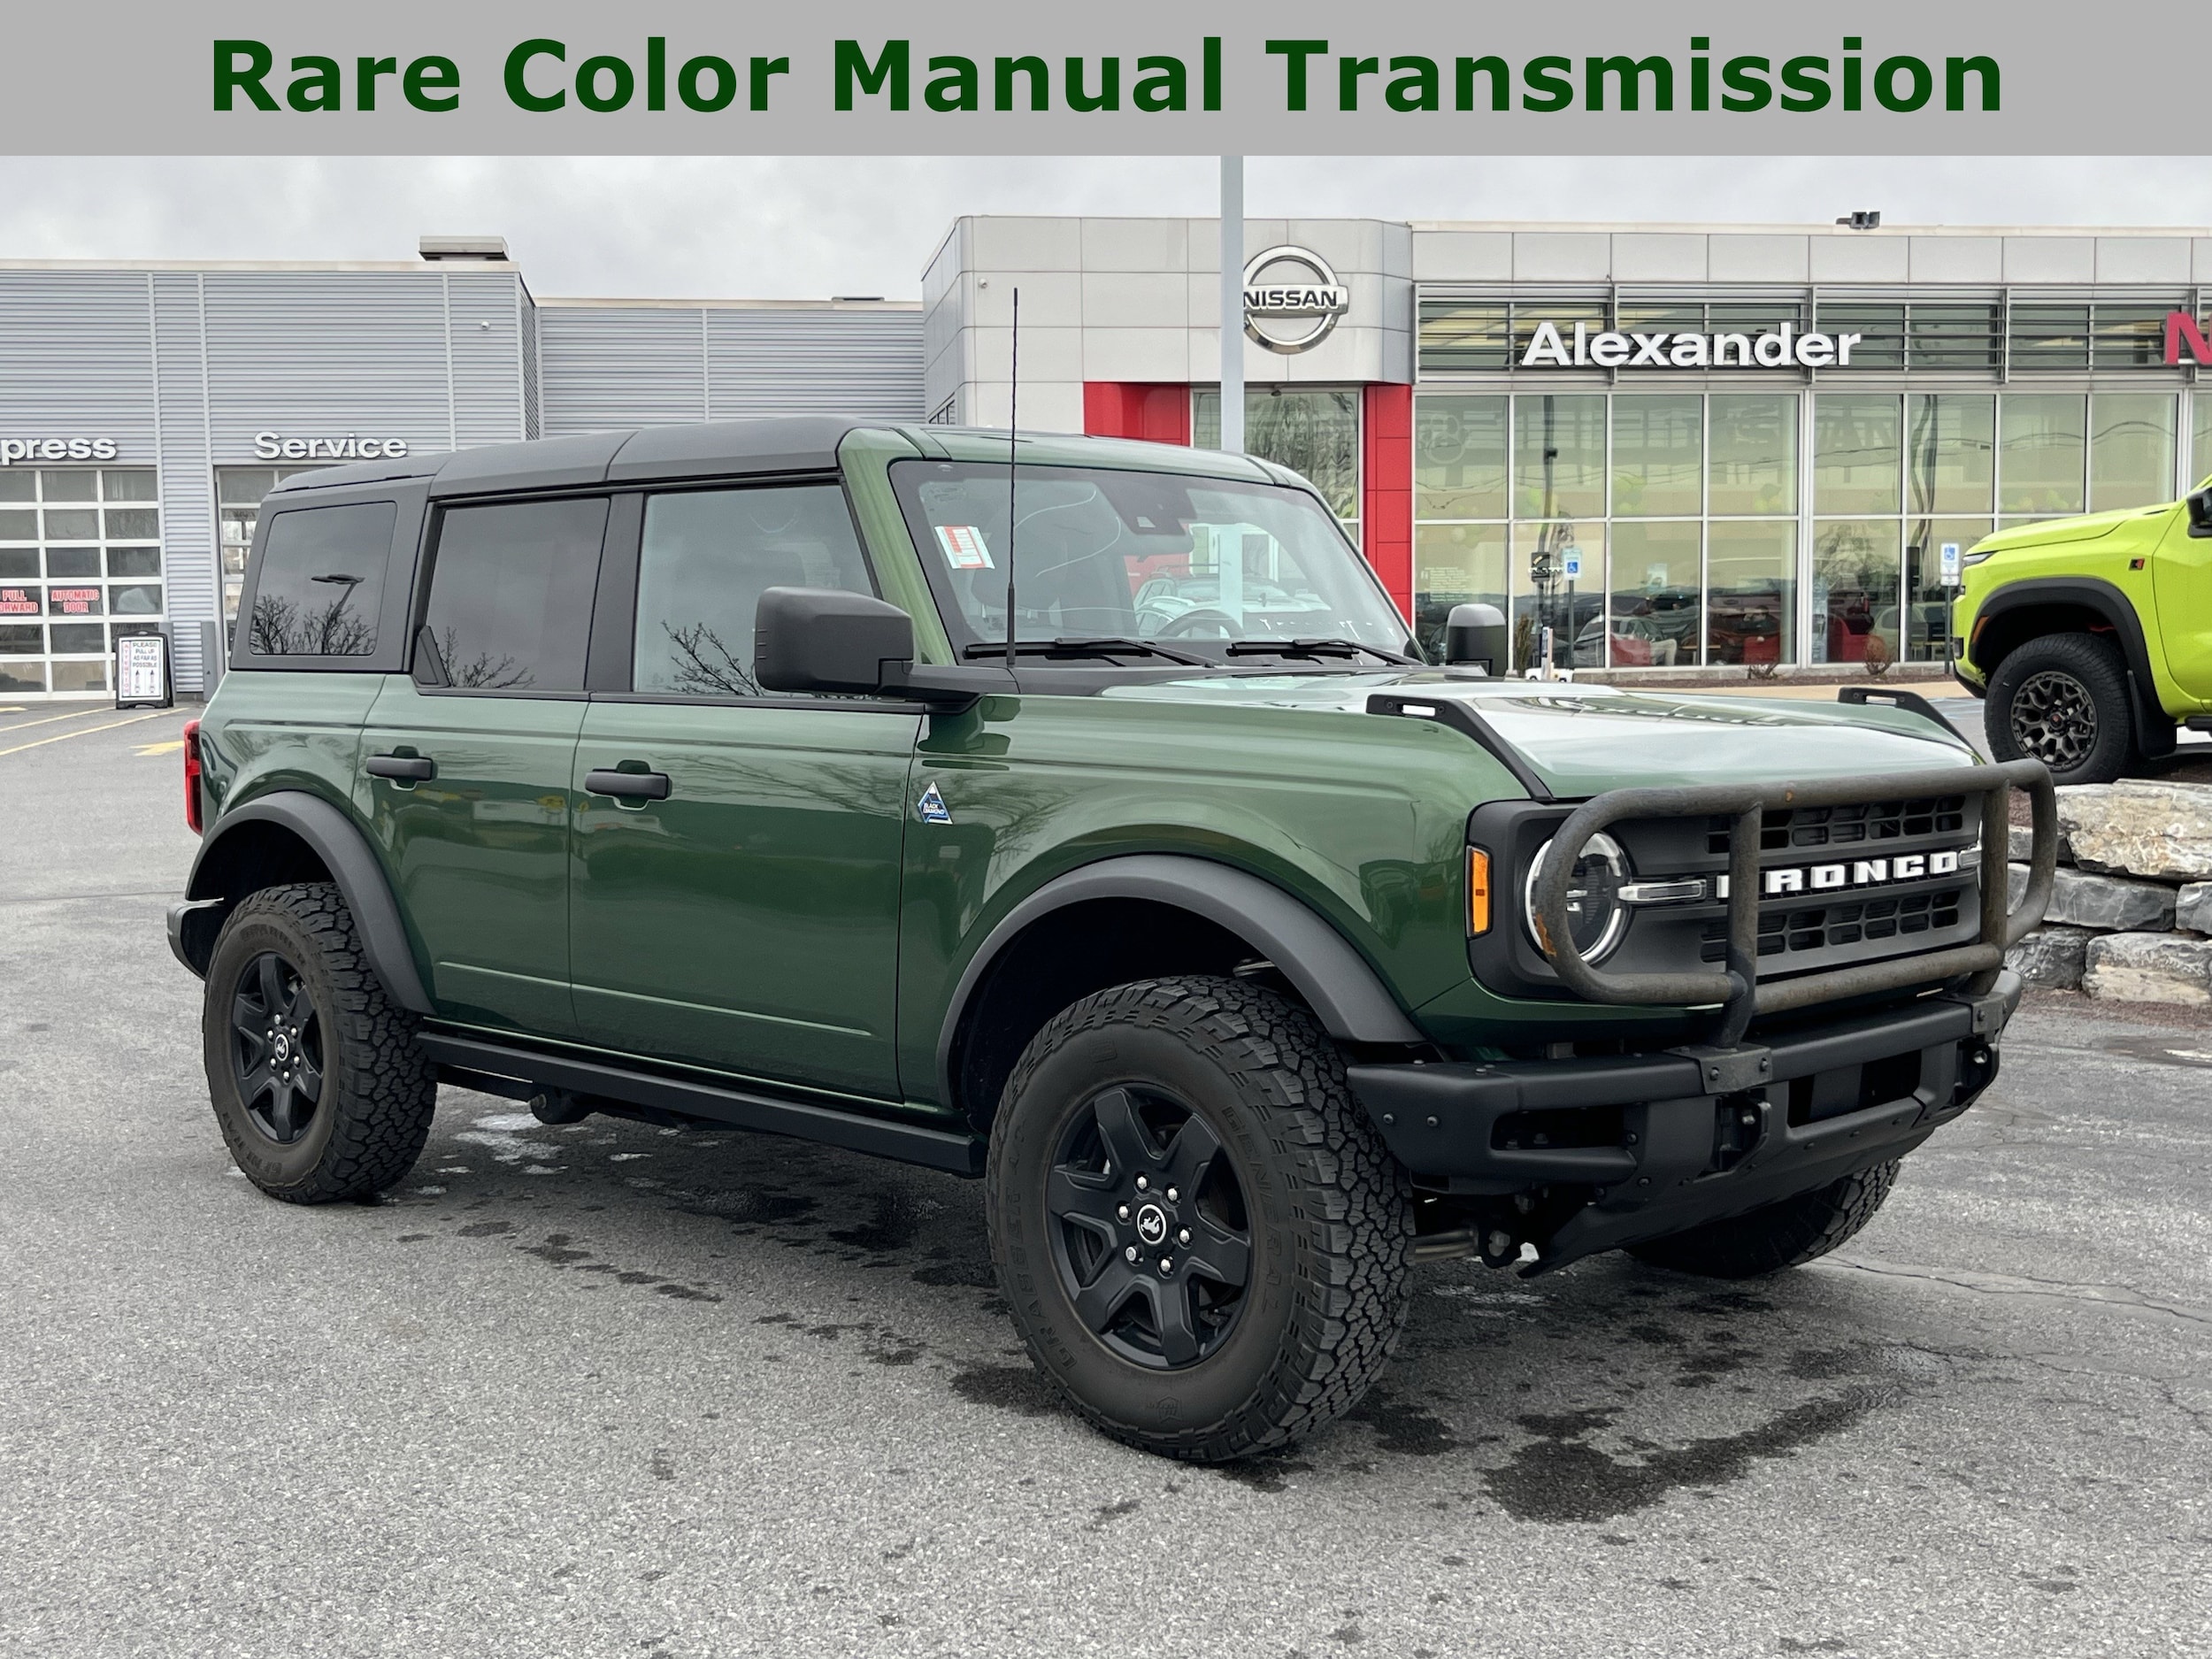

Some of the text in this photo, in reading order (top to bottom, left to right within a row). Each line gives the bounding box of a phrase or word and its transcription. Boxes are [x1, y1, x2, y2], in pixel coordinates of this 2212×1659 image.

[1243, 289, 1338, 308] NISSAN
[1520, 321, 1862, 367] Alexander
[254, 431, 408, 459] Service
[2, 589, 27, 602] PULL
[51, 589, 100, 602] AUTOMATIC
[63, 602, 88, 613] DOOR
[1222, 1106, 1281, 1314] GENERAL
[1005, 1186, 1078, 1370] GRABBER
